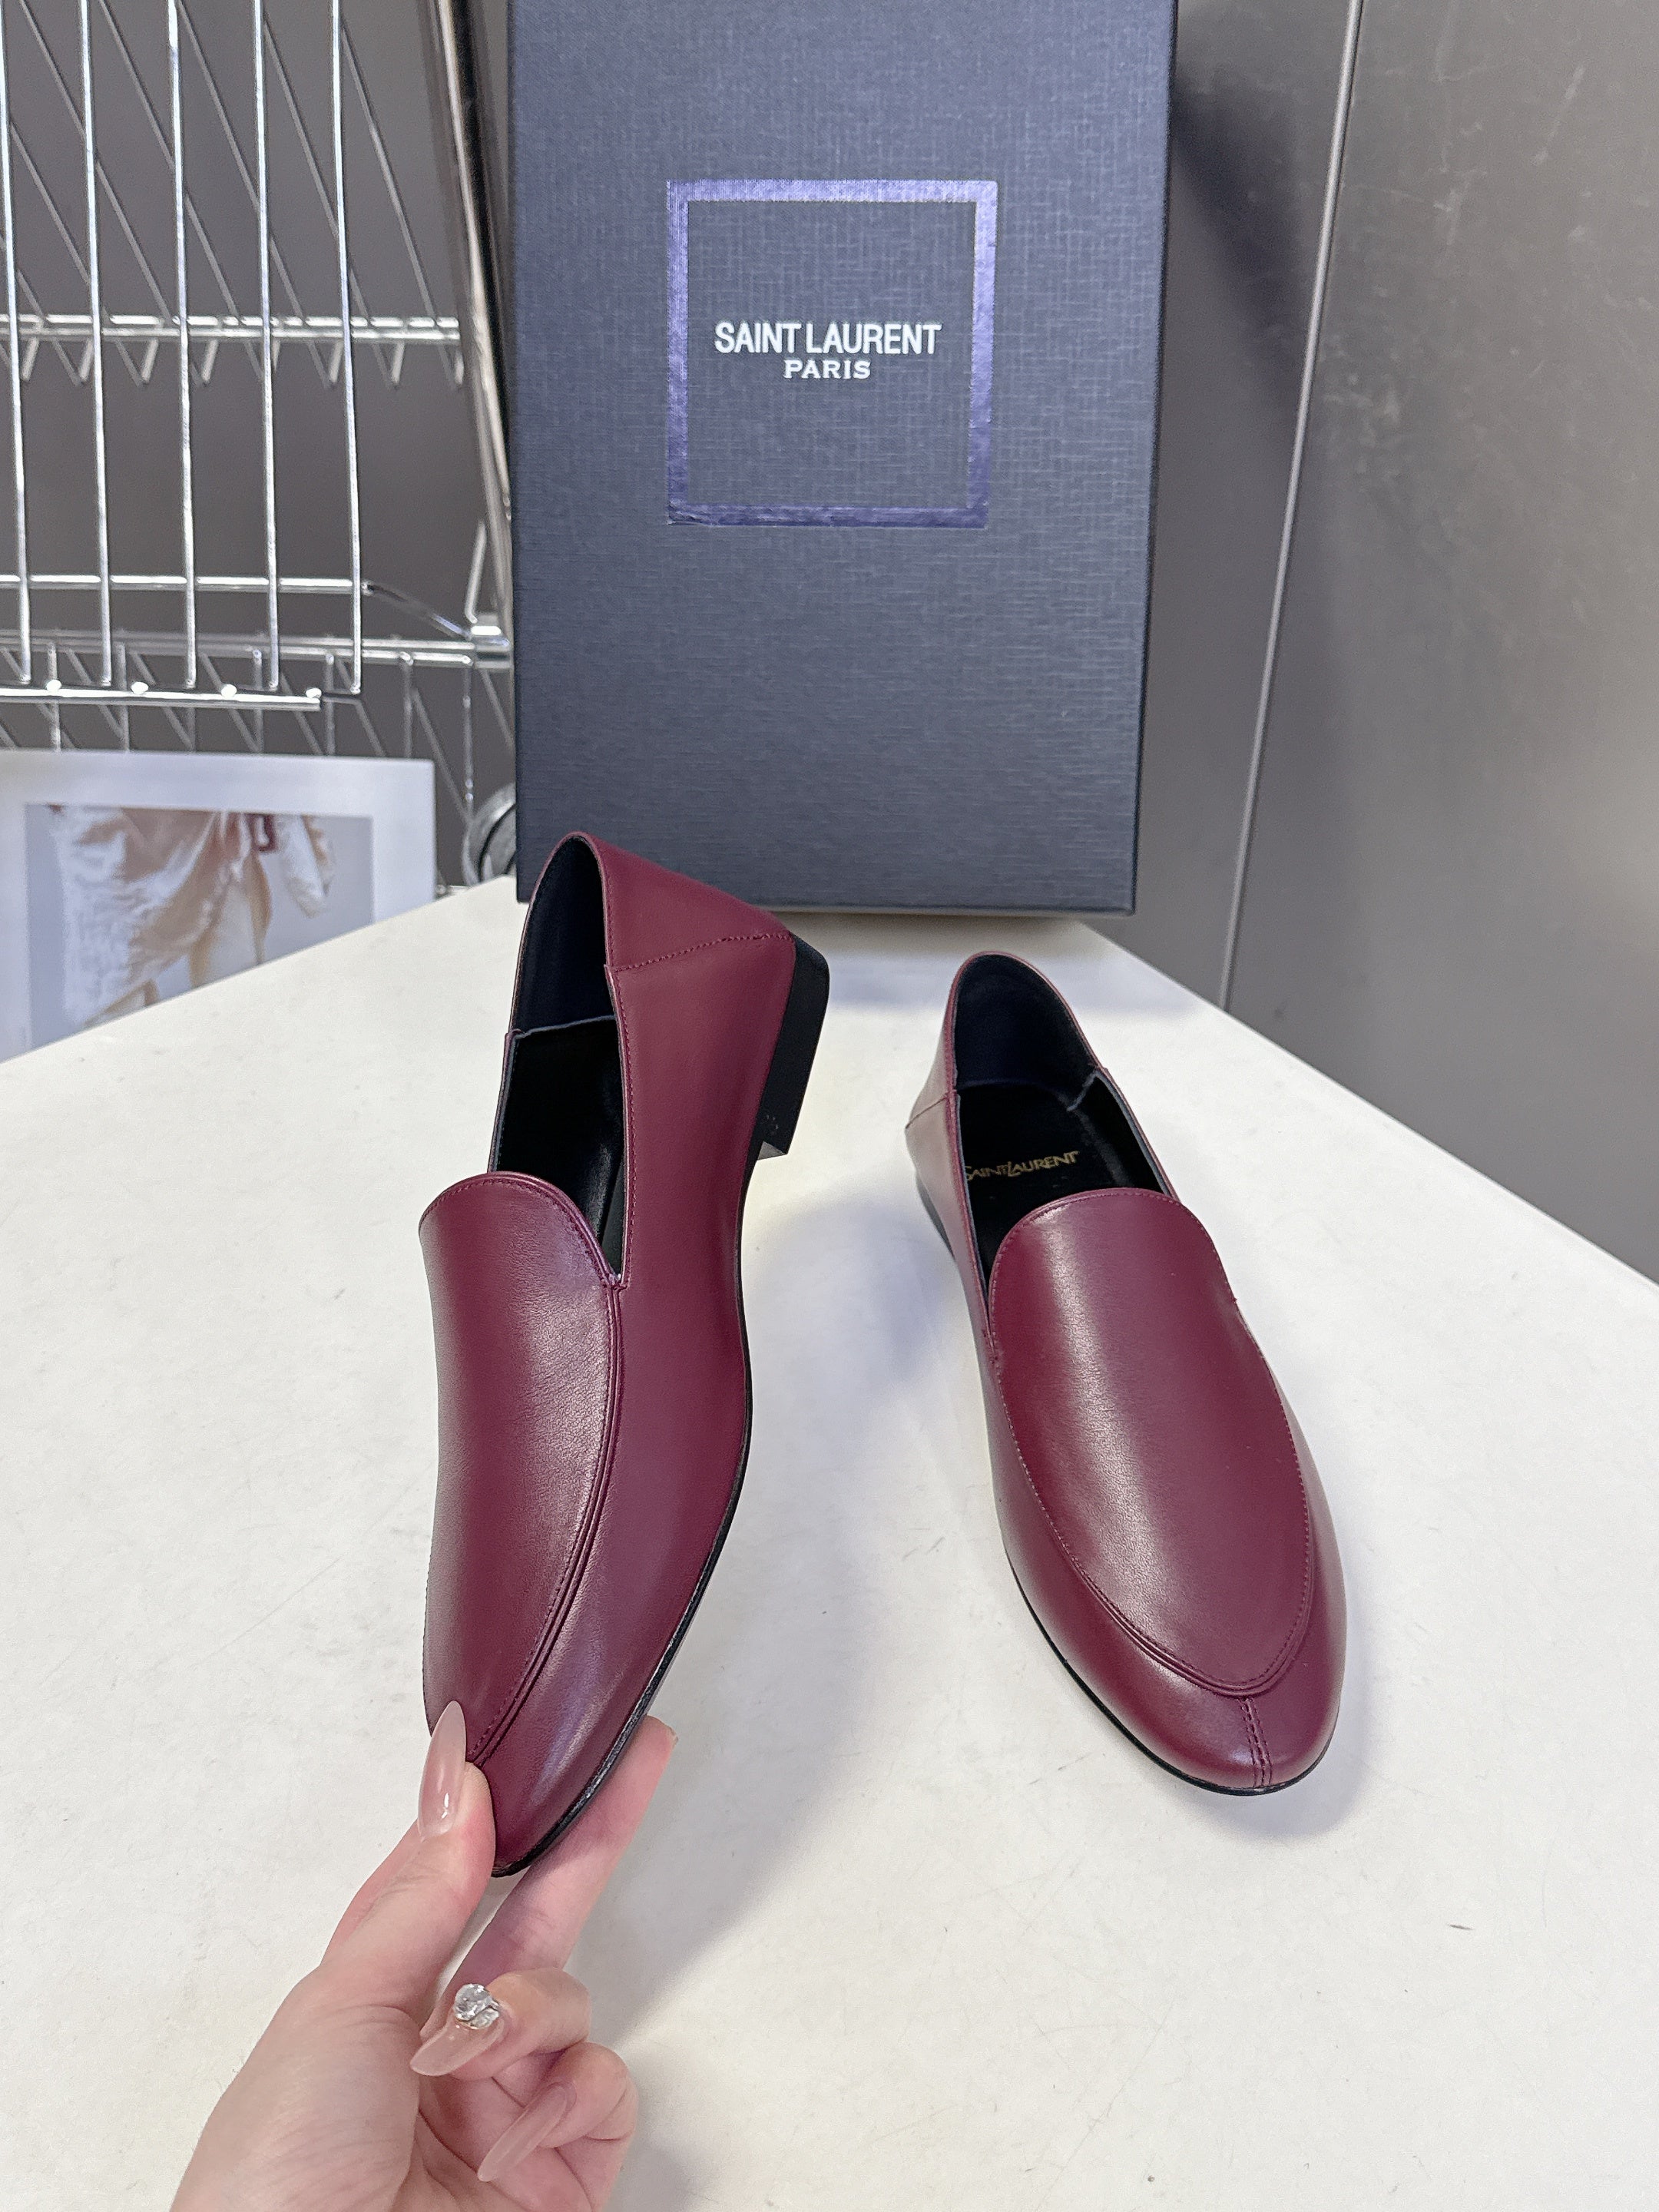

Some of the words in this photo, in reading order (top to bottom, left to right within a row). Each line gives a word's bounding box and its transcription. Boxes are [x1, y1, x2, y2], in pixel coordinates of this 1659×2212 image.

[714, 321, 802, 353] SAINT
[806, 321, 942, 355] LAURENT
[782, 359, 872, 379] PARIS
